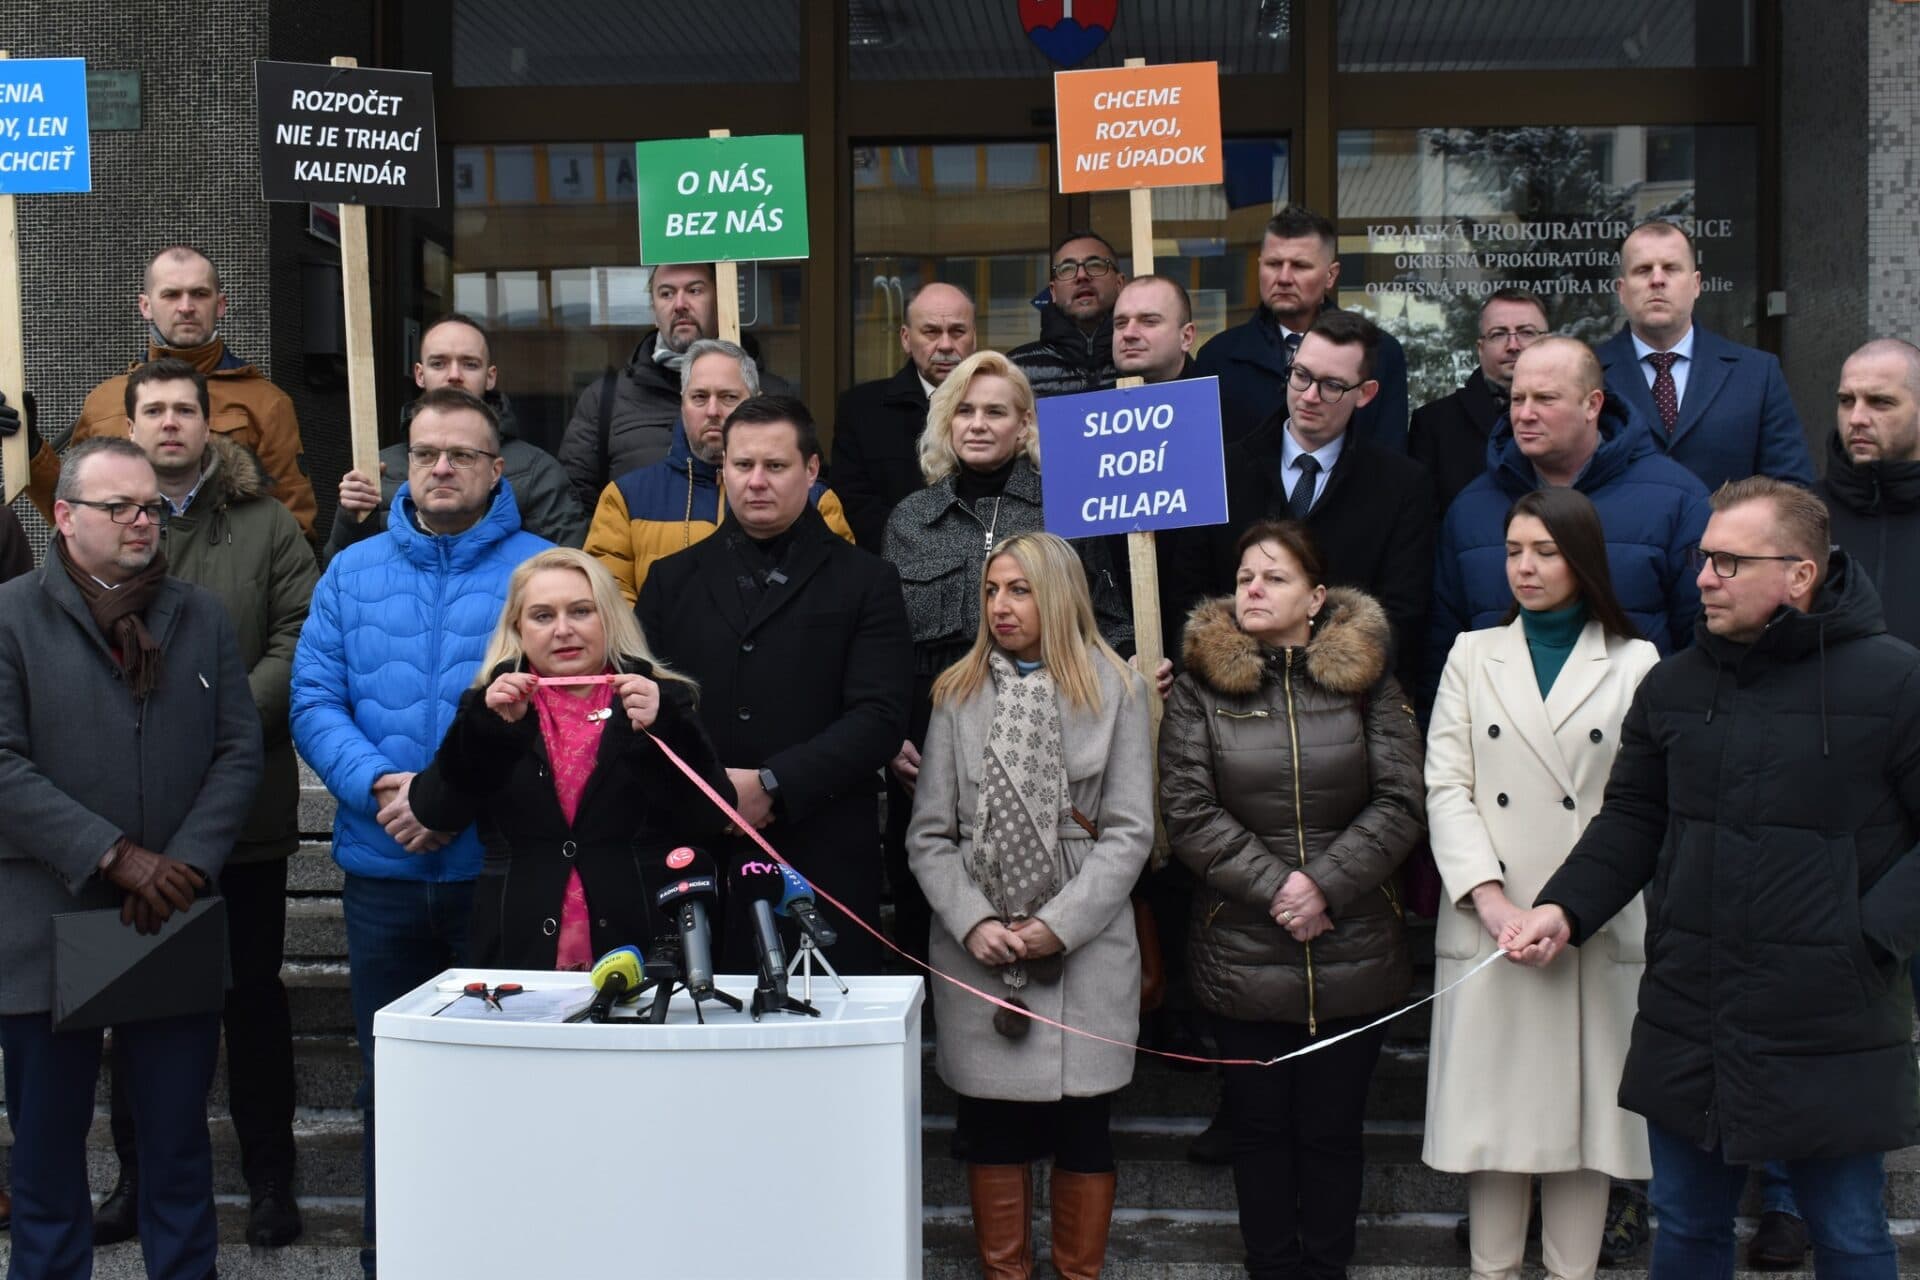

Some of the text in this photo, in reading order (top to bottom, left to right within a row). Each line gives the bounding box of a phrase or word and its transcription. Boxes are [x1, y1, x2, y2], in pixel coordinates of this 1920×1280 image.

[291, 89, 403, 116] ROZPOČET
[1093, 86, 1182, 111] CHCEME
[27, 116, 68, 137] LEN
[276, 123, 423, 152] NIE JE TRHACÍ
[1095, 117, 1182, 141] ROZVOJ,
[0, 145, 75, 172] CHCIEŤ
[1075, 145, 1207, 173] NIE ÚPADOK
[294, 159, 407, 186] KALENDÁR
[677, 162, 773, 196] O NÁS,
[665, 202, 784, 237] BEZ NÁS
[1367, 219, 1464, 241] KRAJSKÁ
[1472, 214, 1640, 241] PROKURATÚR
[1395, 250, 1480, 269] OKRESNÁ
[1484, 248, 1621, 268] PROKURATÚRA
[1365, 279, 1452, 297] OKRESNÁ
[1701, 276, 1734, 293] olie
[1083, 403, 1175, 438] SLOVO
[1098, 440, 1169, 479] ROBÍ
[1081, 488, 1188, 522] CHLAPA
